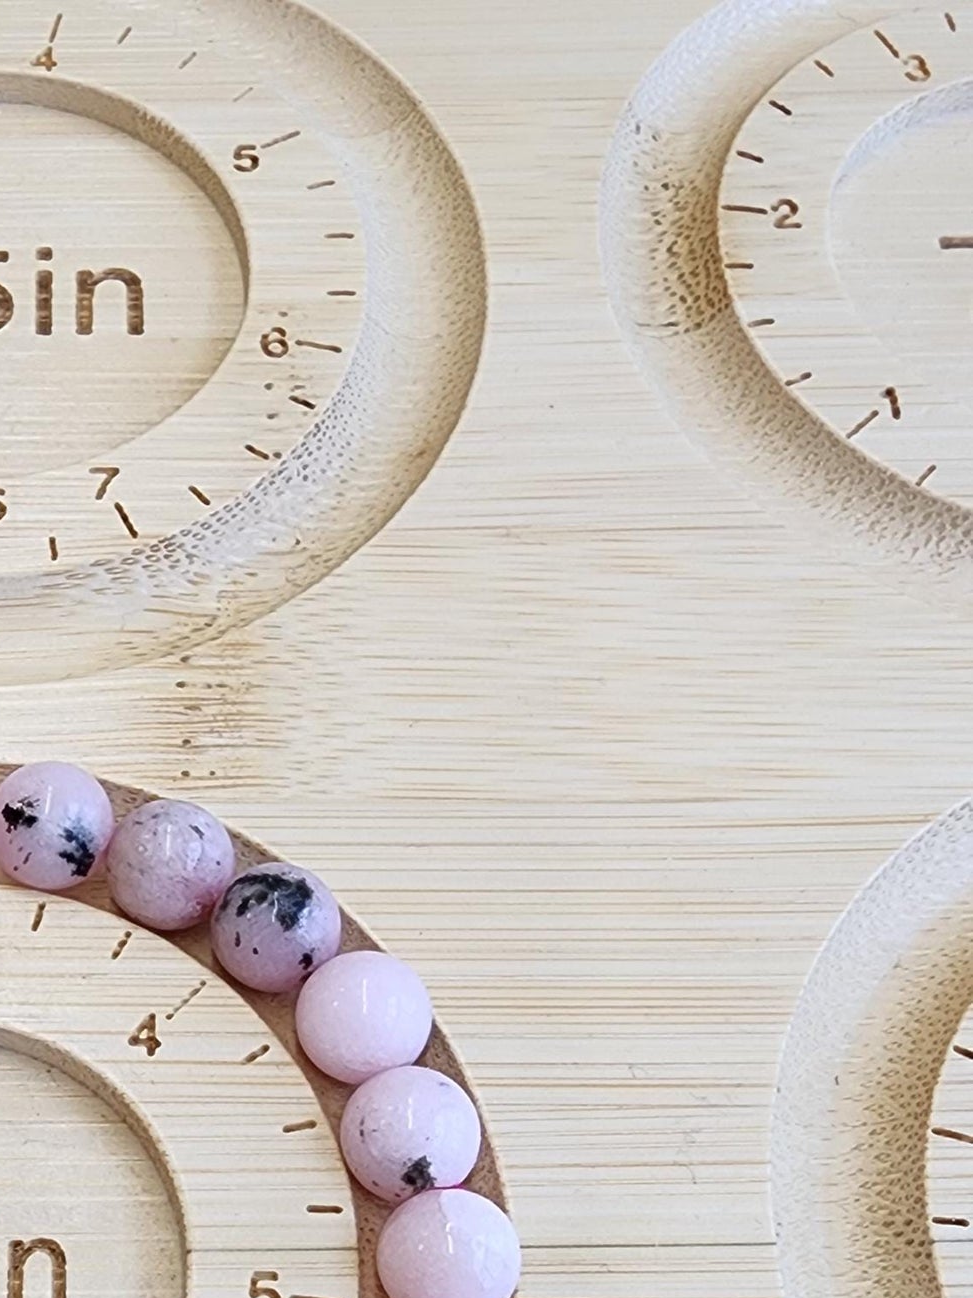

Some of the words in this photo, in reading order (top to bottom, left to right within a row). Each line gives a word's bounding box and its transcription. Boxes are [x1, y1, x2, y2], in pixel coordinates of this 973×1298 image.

[30, 46, 58, 71] 4
[903, 54, 930, 81] 3
[232, 145, 260, 171] 5
[770, 198, 802, 228] 2
[259, 327, 289, 358] 6
[881, 387, 900, 419] 1
[89, 467, 119, 500] 7
[127, 1015, 161, 1055] 4
